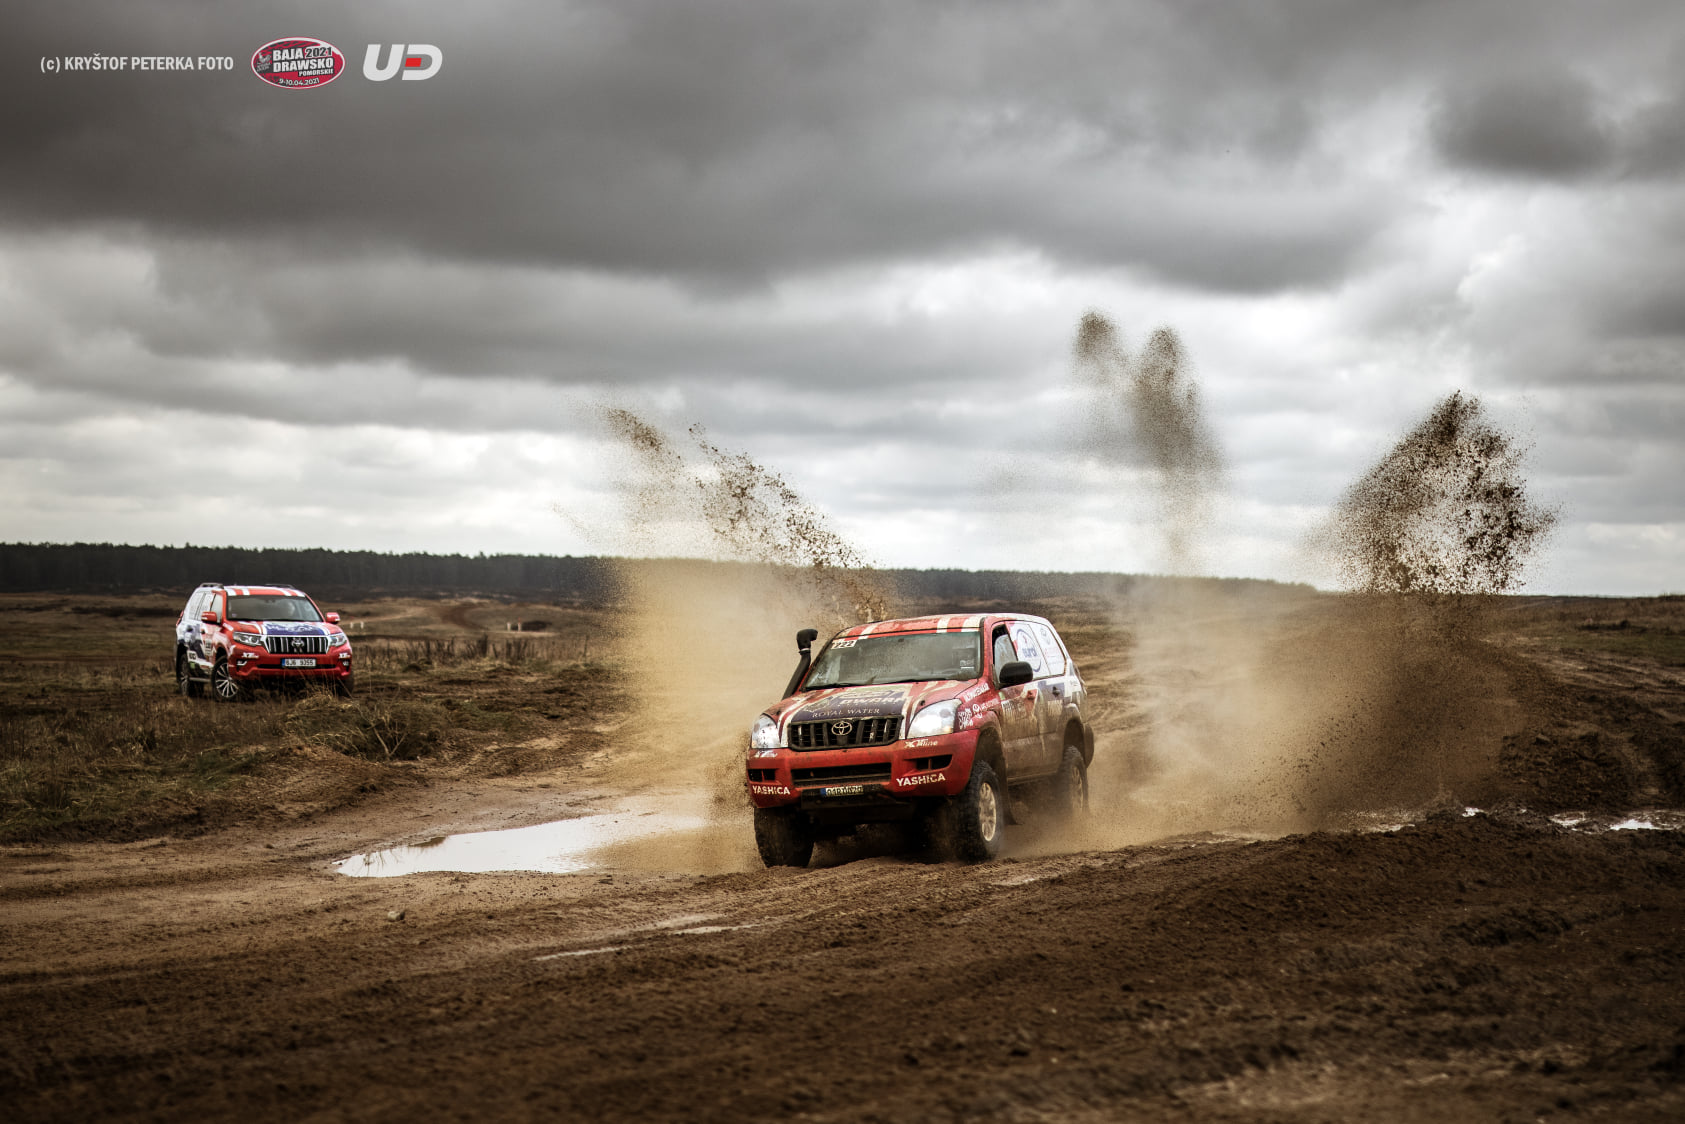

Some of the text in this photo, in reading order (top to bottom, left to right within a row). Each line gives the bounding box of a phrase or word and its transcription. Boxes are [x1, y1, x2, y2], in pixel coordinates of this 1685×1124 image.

[812, 707, 881, 719] ROYAL WATER
[895, 772, 946, 787] YASHICA
[752, 785, 791, 795] YASHICA
